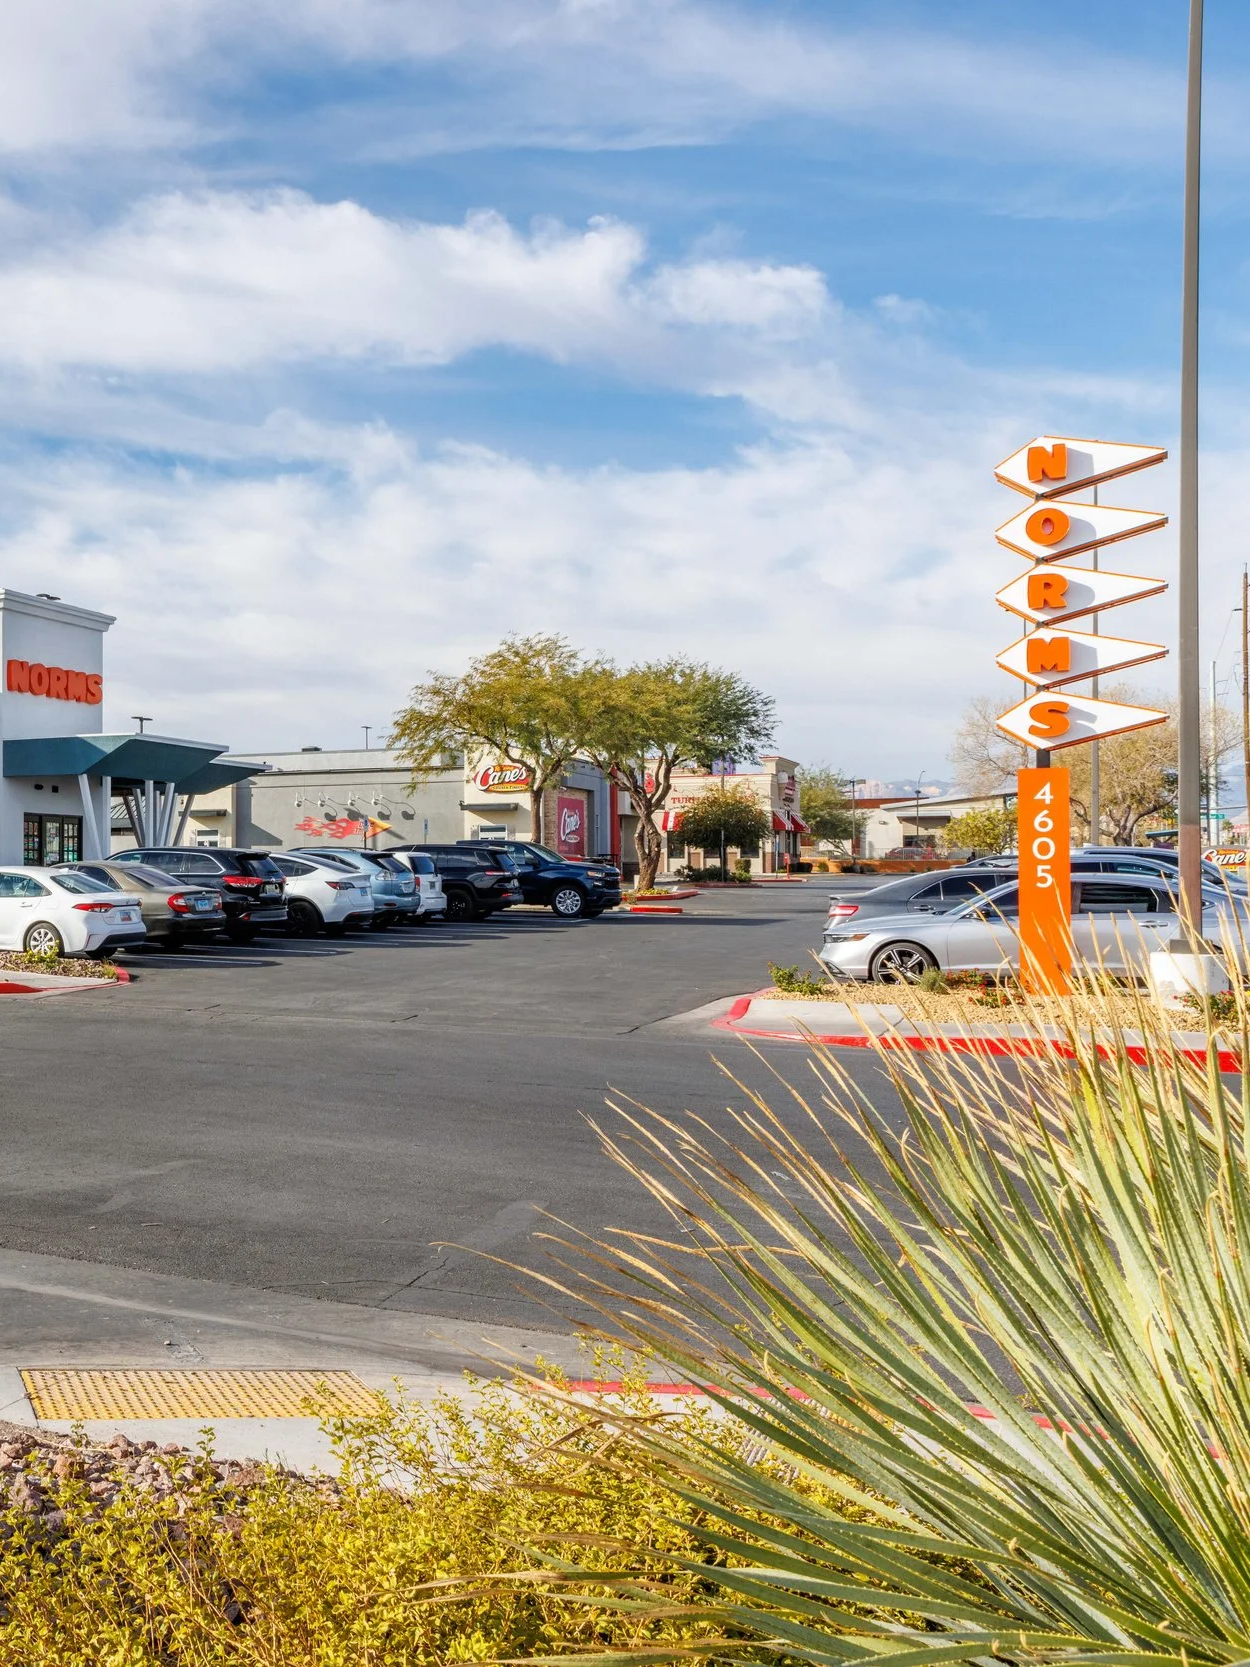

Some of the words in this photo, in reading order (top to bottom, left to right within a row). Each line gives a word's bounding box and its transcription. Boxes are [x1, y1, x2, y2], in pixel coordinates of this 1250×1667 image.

[1026, 443, 1070, 737] NORMS
[7, 659, 103, 705] NORMS
[1032, 782, 1055, 888] 4605
